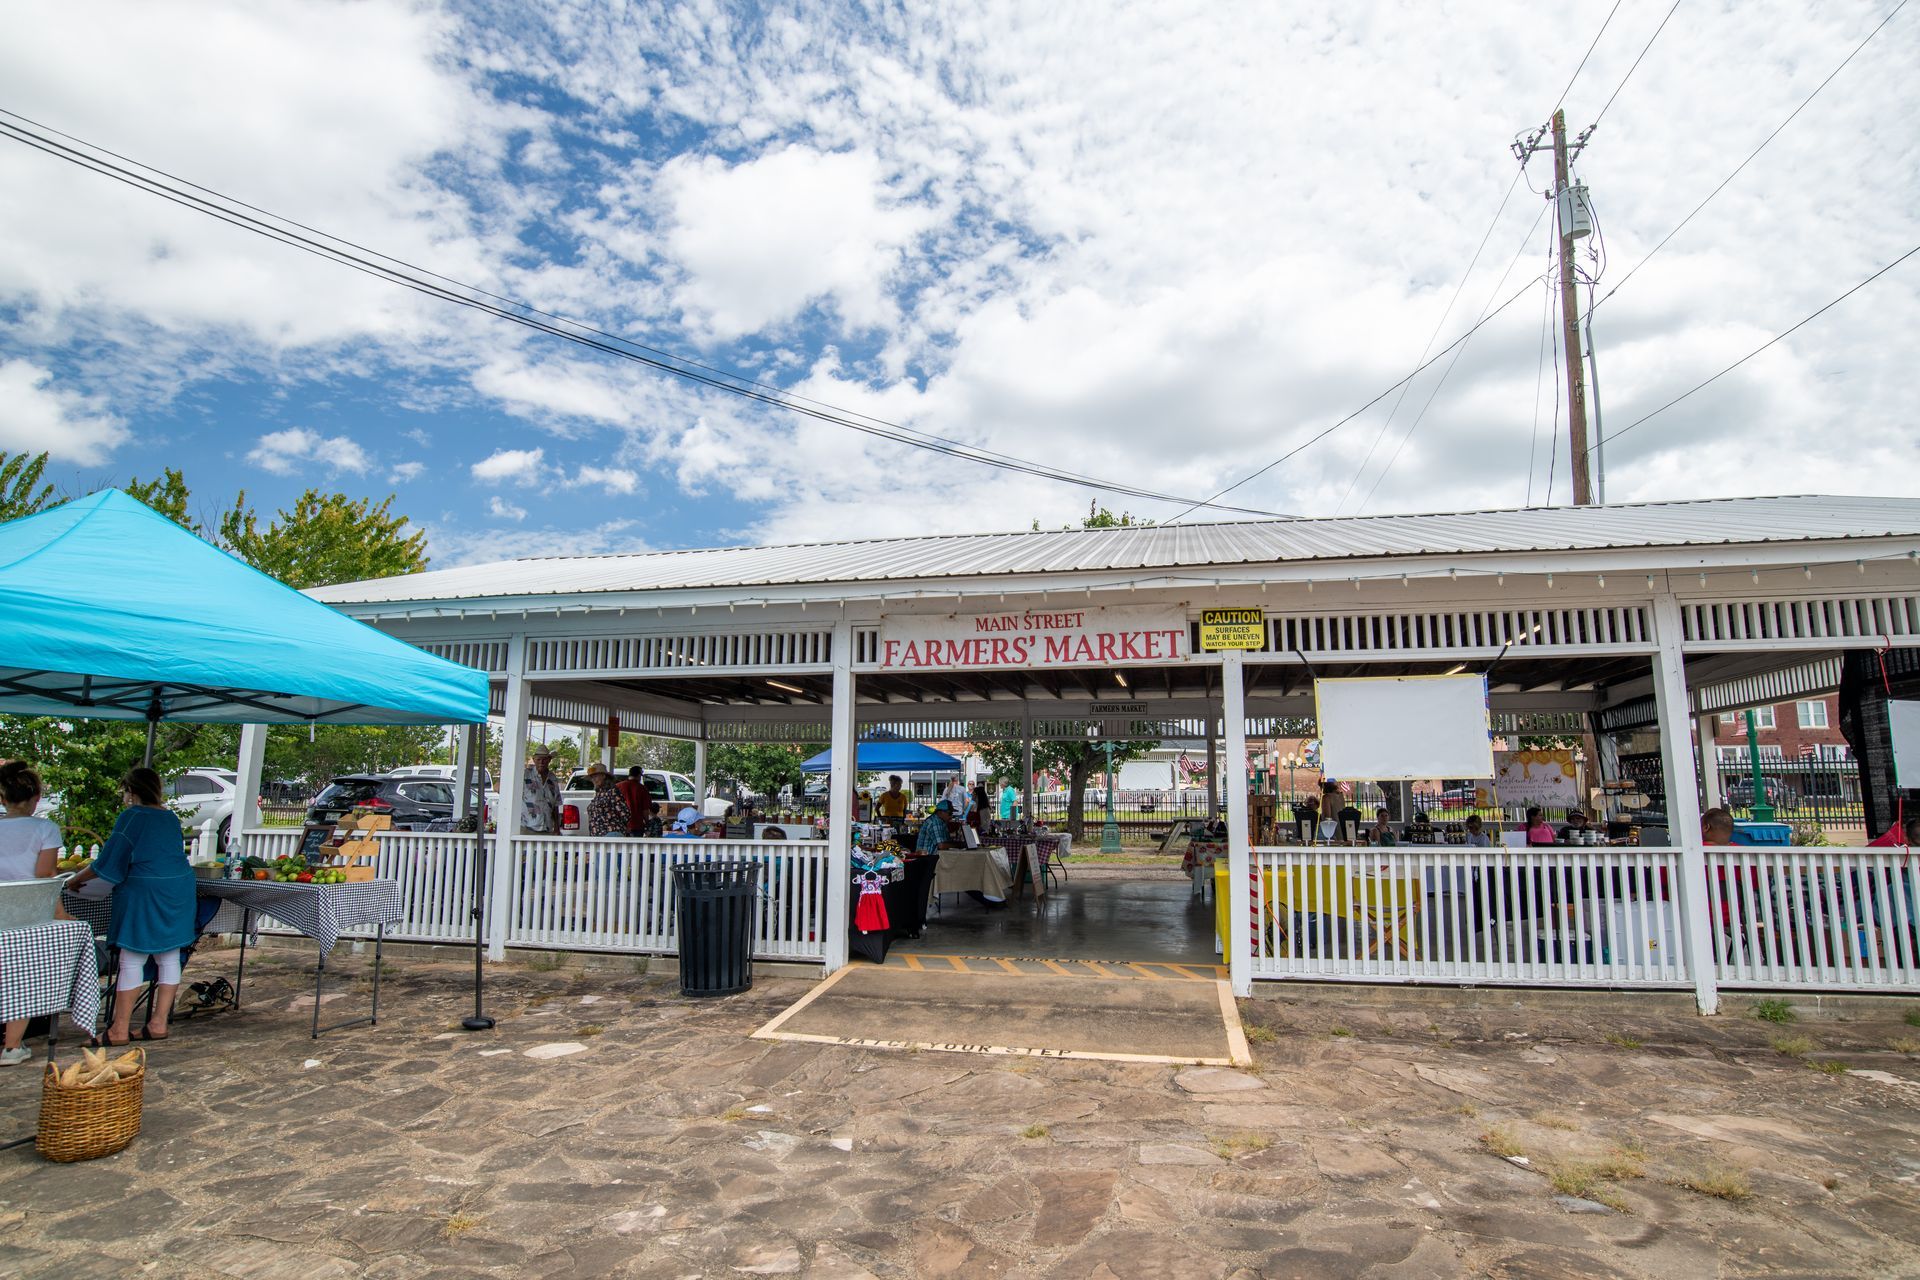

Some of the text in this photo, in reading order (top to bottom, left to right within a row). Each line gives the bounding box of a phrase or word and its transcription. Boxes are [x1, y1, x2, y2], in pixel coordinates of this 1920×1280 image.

[975, 612, 1085, 632] MAIN STREET
[1205, 612, 1259, 623] CAUTION
[883, 630, 1185, 667] FARMERS' MARKET
[930, 1042, 992, 1052] YOUR
[1005, 1046, 1072, 1056] STEP
